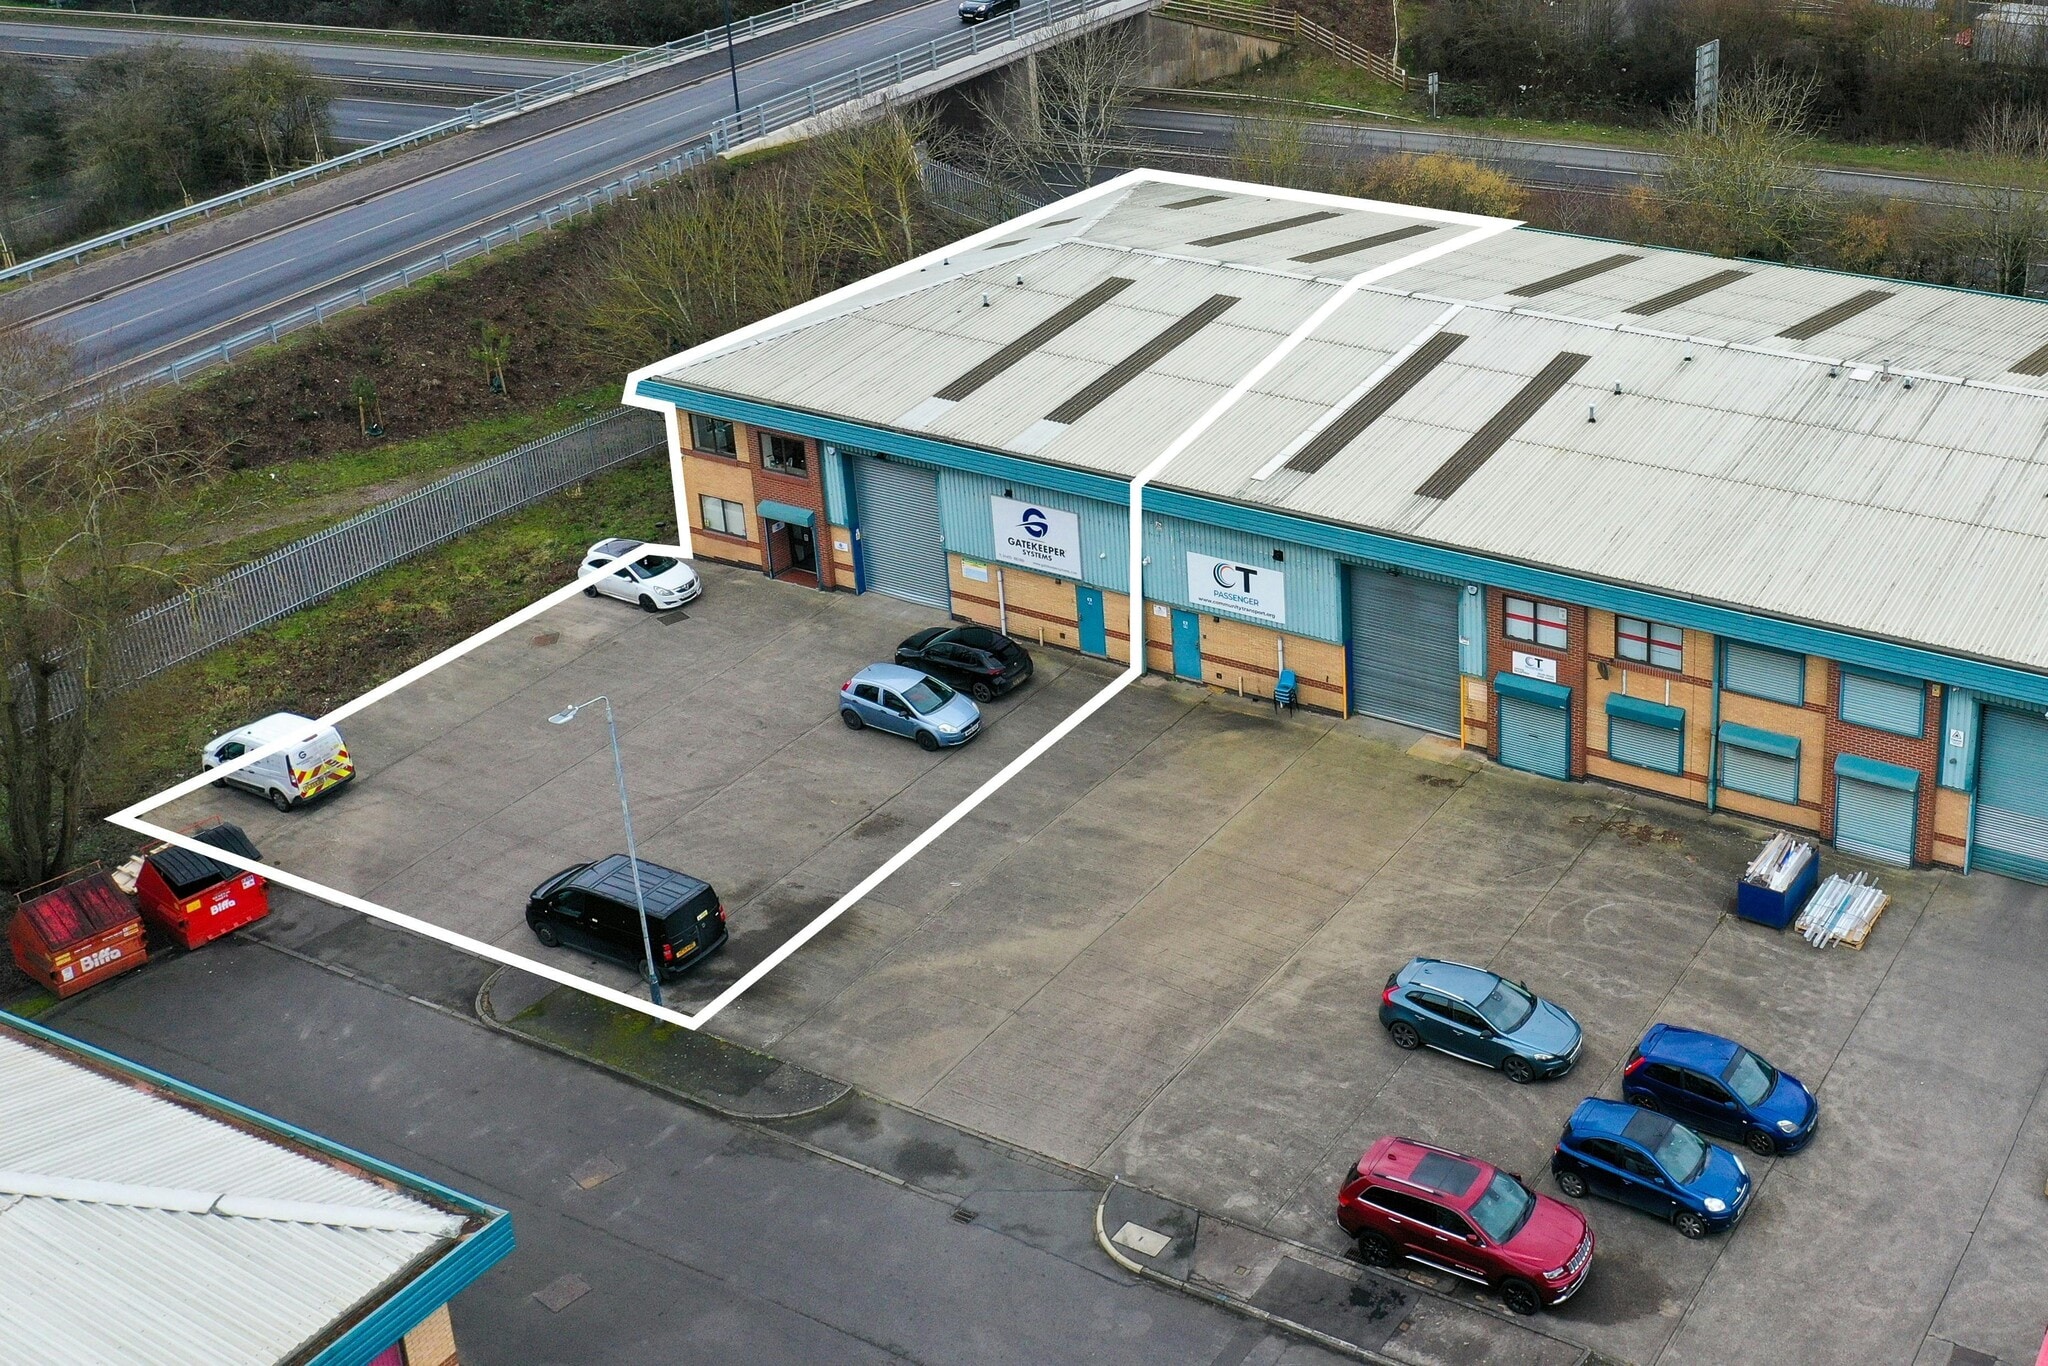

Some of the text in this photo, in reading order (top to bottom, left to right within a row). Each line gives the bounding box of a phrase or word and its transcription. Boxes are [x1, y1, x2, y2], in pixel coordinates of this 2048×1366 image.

[1007, 537, 1066, 558] GATEKEEPER
[1022, 549, 1053, 562] SYSTEMS
[1213, 561, 1258, 593] CT
[1213, 590, 1260, 607] PASSENGER
[1524, 656, 1544, 669] CT
[209, 899, 236, 916] Biffa
[80, 947, 122, 973] Biffa
